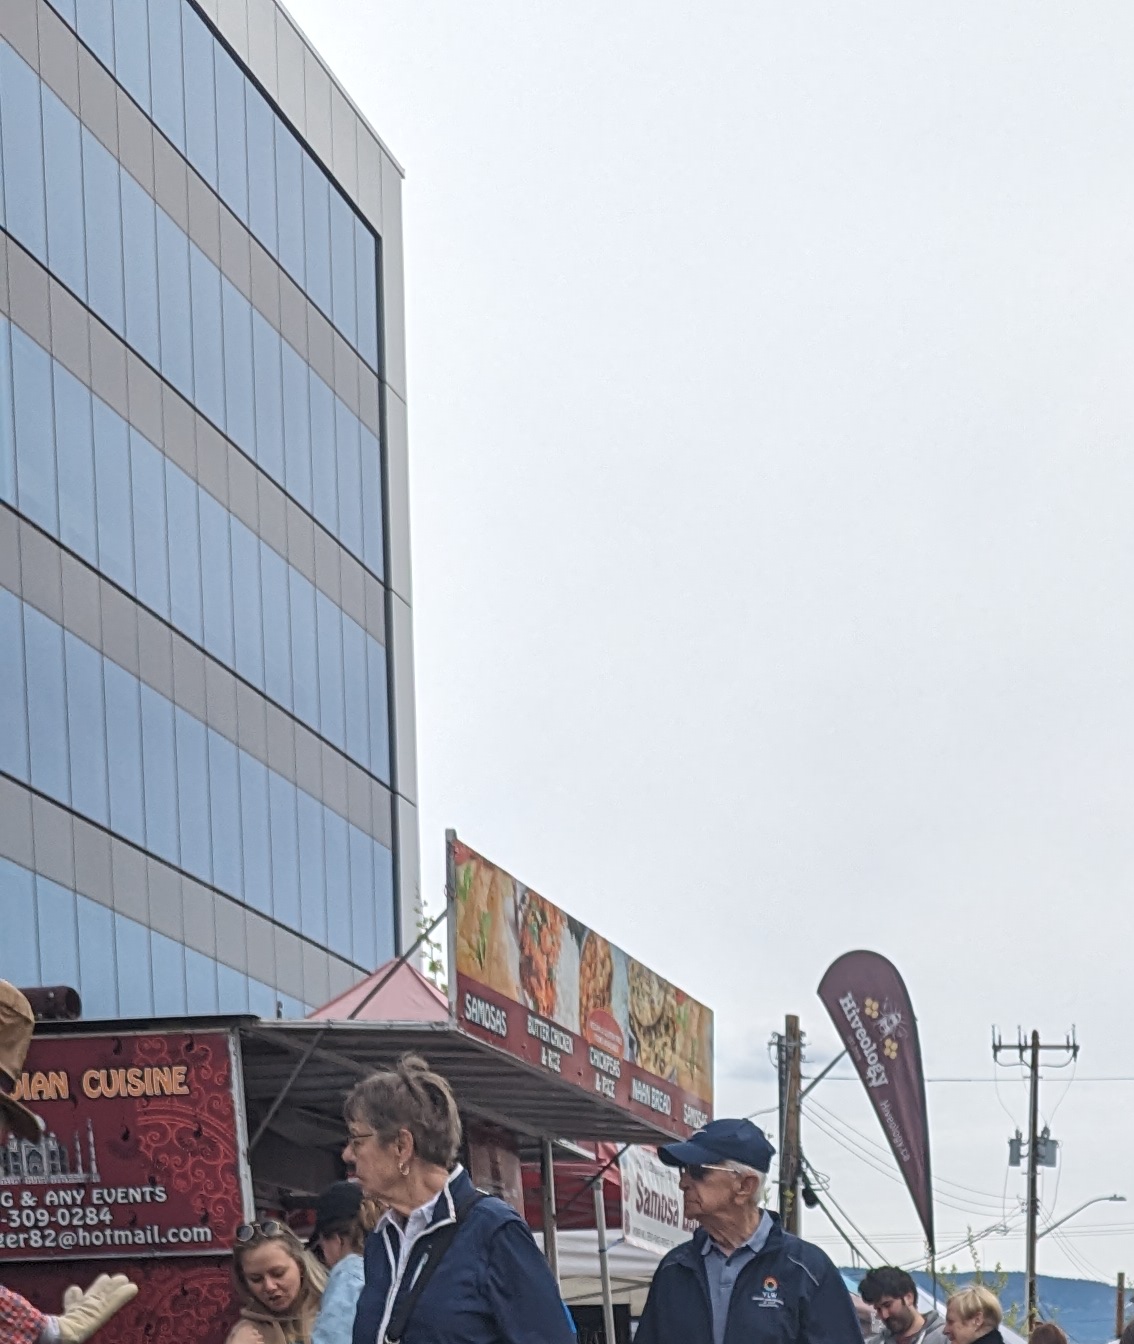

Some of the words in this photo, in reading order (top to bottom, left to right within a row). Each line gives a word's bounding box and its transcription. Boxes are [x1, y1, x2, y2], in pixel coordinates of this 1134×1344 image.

[464, 993, 507, 1037] SAMOSAS
[527, 1014, 550, 1042] BUTTER
[551, 1027, 574, 1055] CHICKEN
[840, 992, 888, 1088] Hiveology
[82, 1066, 190, 1098] CUISINE
[632, 1078, 651, 1107] NAAN
[651, 1087, 671, 1116] BREAD
[20, 1191, 38, 1206] &
[45, 1189, 85, 1205] ANY
[92, 1186, 168, 1204] EVENTS
[636, 1171, 679, 1229] Samosa
